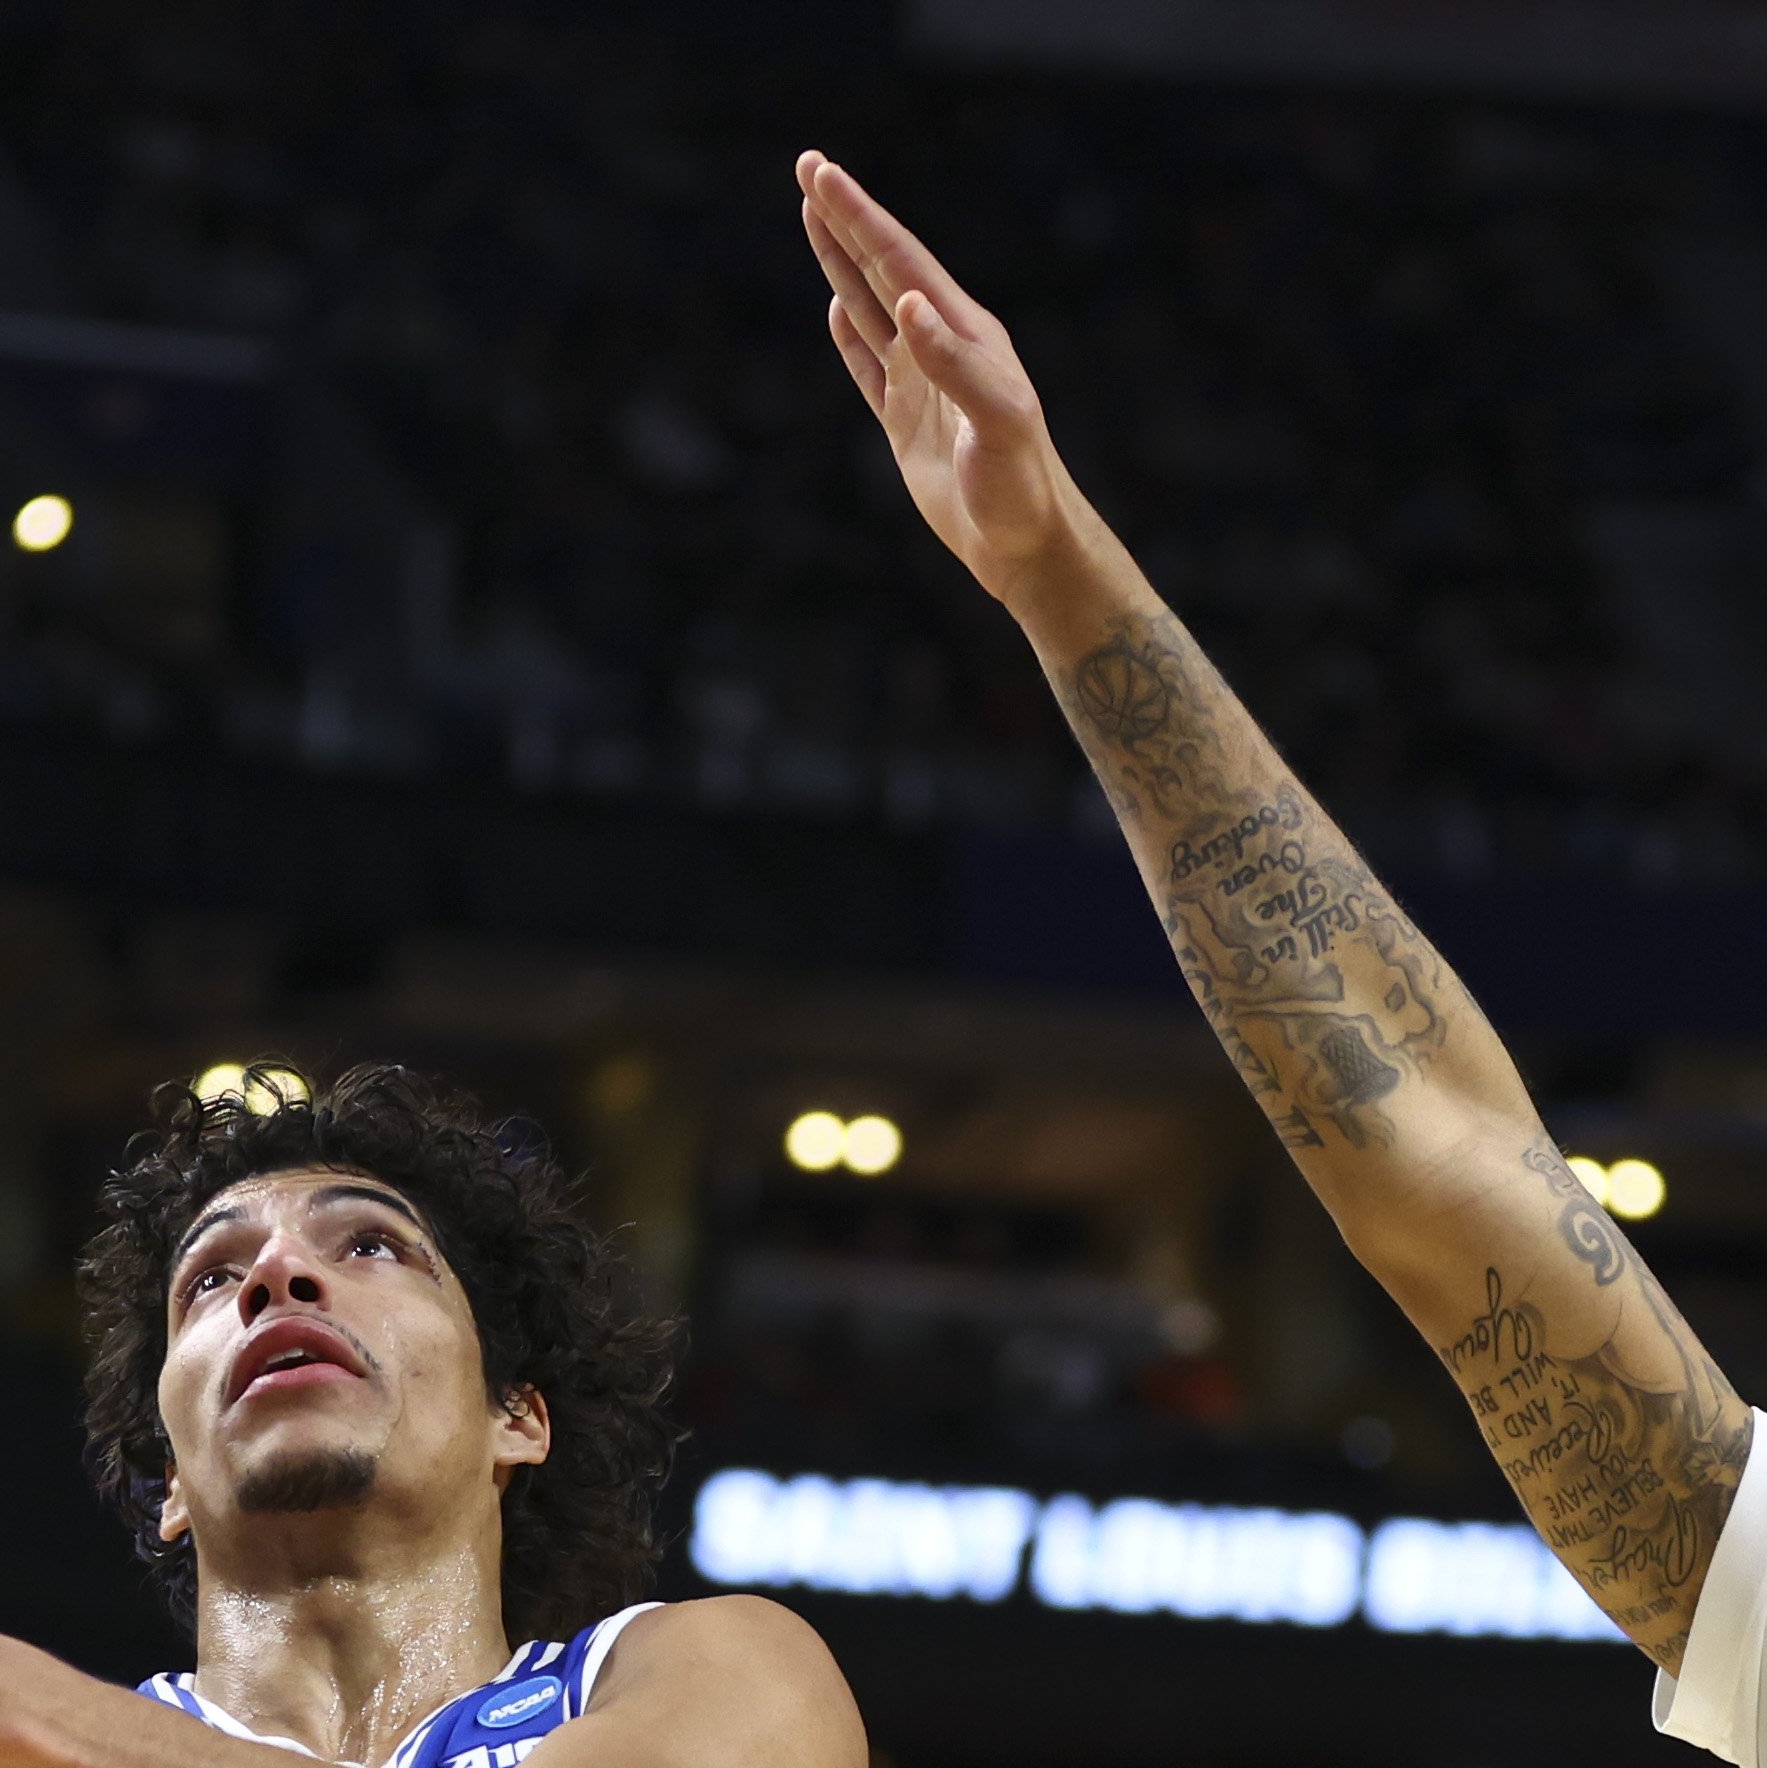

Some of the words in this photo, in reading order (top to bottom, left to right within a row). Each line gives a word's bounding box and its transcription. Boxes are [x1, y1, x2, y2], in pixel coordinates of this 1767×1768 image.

[1499, 1351, 1558, 1399] WILL
[1503, 1396, 1553, 1438] AND
[487, 1685, 557, 1723] NCAA
